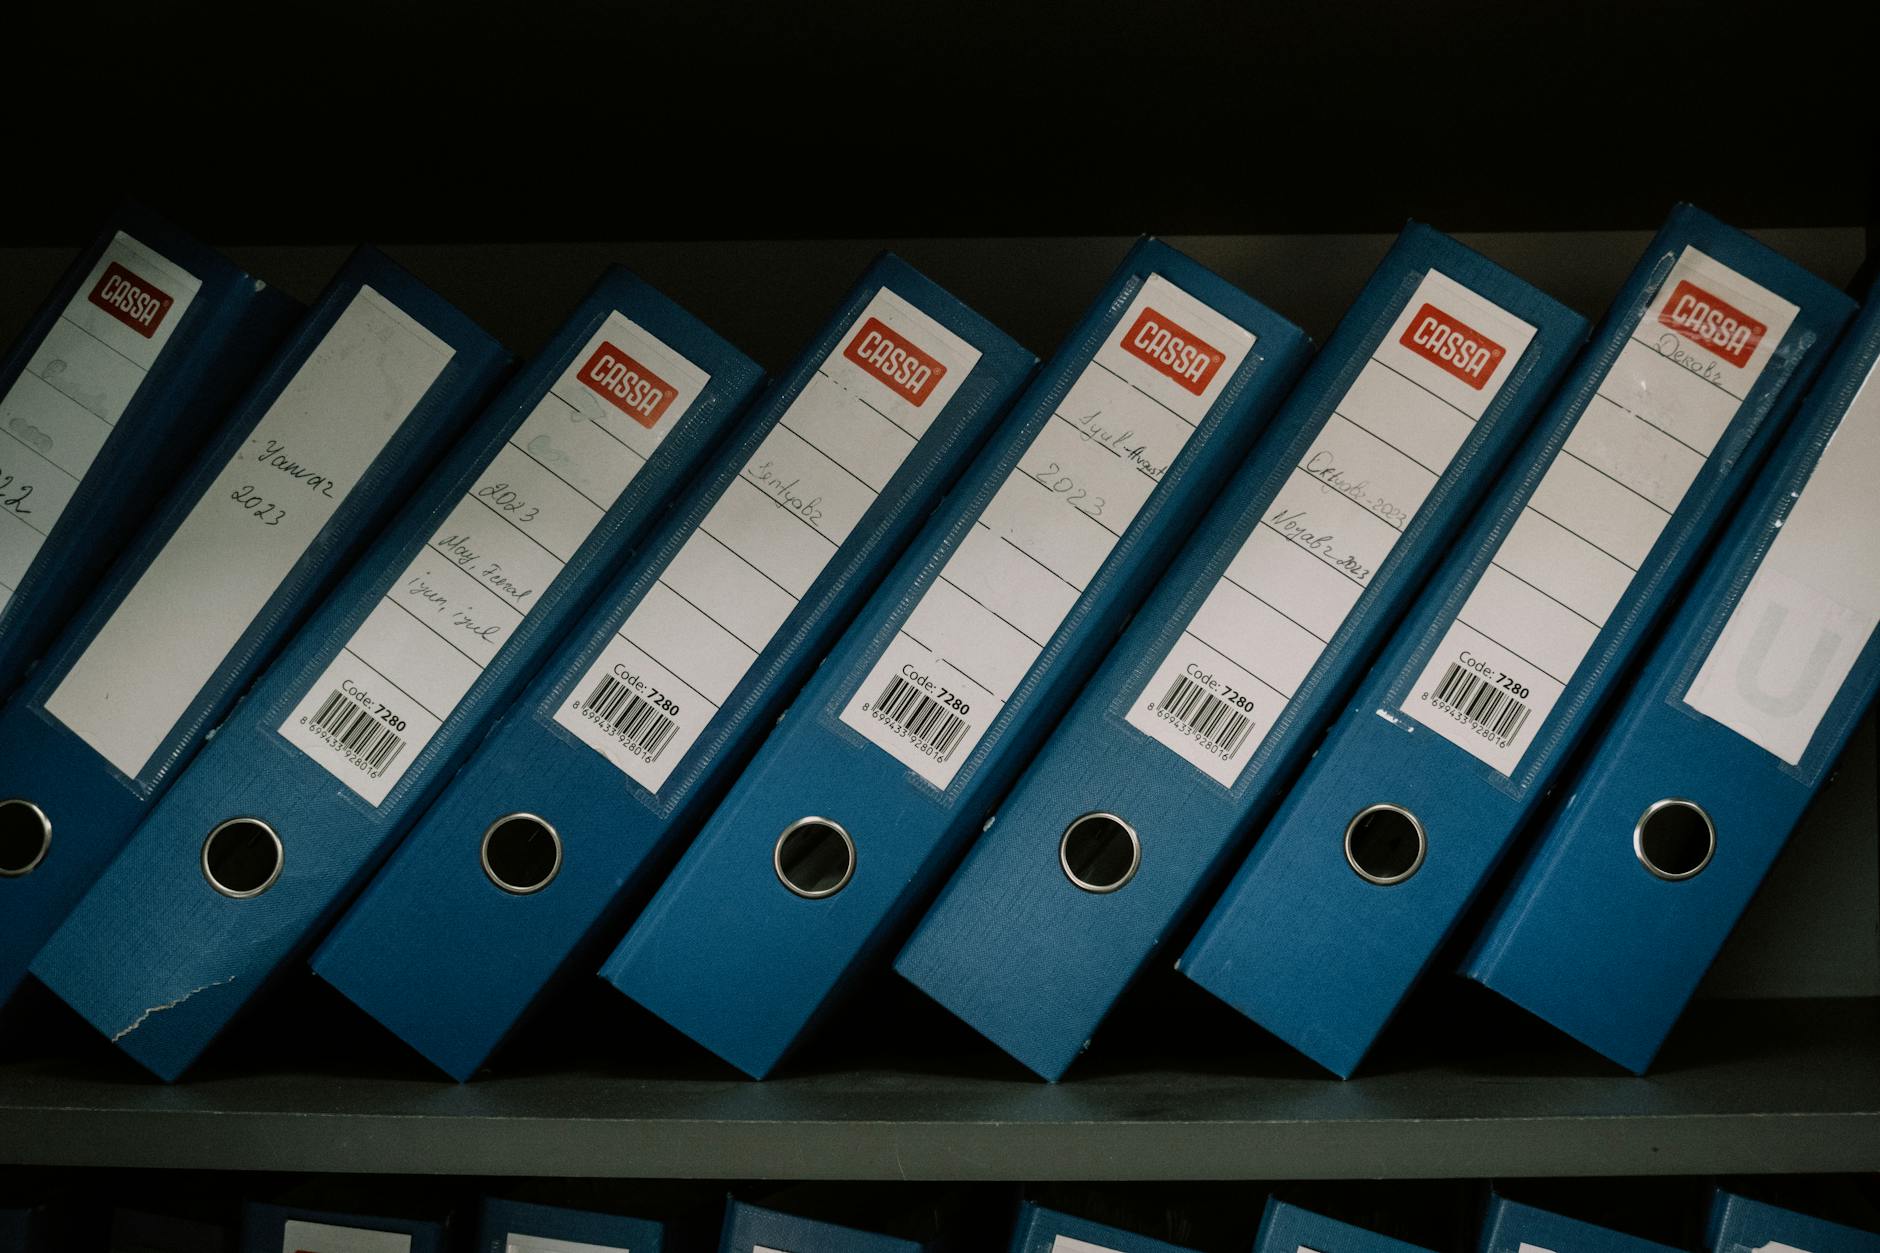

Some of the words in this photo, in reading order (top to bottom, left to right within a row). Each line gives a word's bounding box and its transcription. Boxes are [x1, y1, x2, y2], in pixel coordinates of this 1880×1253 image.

[101, 275, 161, 326] CASSA
[1671, 294, 1751, 357] CASSA
[857, 331, 932, 394] CASSA
[1133, 321, 1211, 383] CASSA
[1412, 316, 1491, 378] CASSA
[589, 354, 663, 417] CASSA
[231, 485, 286, 526] 2023
[478, 483, 540, 522] 2023
[1036, 463, 1107, 517] 2023
[1337, 555, 1370, 581] 2023
[613, 663, 647, 694] Code:
[647, 688, 680, 716] 7280
[902, 664, 937, 694] Code:
[937, 687, 970, 715] 7280
[1186, 663, 1221, 692] Code:
[1221, 685, 1254, 713] 7280
[1459, 651, 1495, 679] Code:
[1496, 672, 1530, 699] 7280
[342, 679, 375, 709] Code:
[374, 704, 407, 732] 7280
